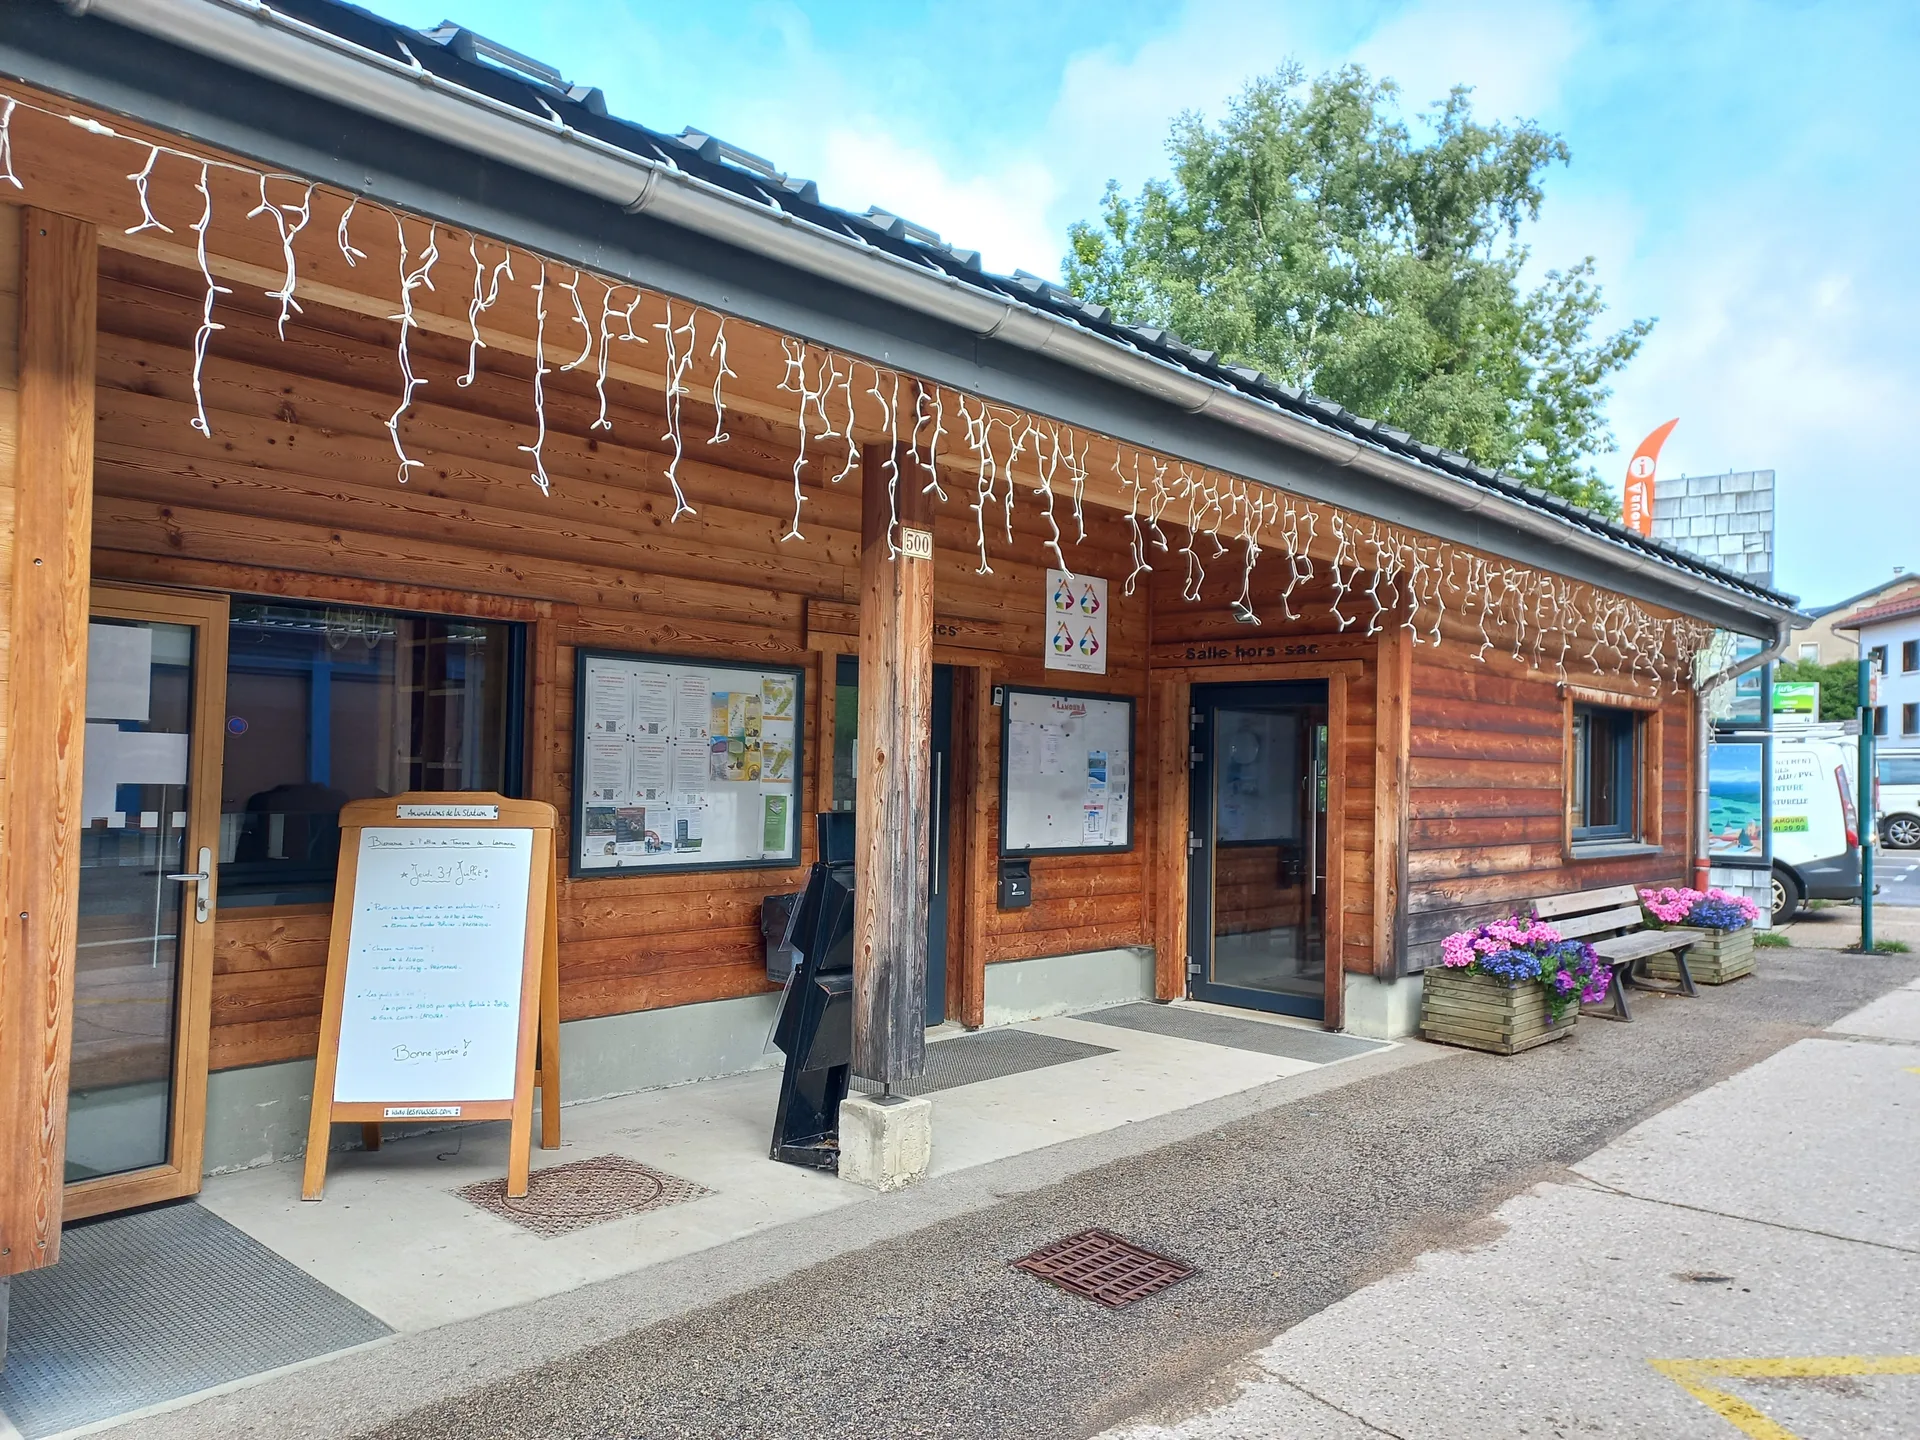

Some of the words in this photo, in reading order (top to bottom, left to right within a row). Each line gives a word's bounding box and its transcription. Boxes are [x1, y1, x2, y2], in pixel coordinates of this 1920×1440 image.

[906, 533, 930, 554] 500
[1185, 646, 1228, 660] Salle
[1235, 644, 1276, 658] hors
[1284, 643, 1319, 656] sac
[1772, 798, 1808, 806] ATURELLE
[407, 808, 445, 817] Animations
[445, 808, 453, 817] de
[453, 807, 461, 817] la
[462, 808, 487, 817] Station
[1773, 817, 1805, 825] AMOURA
[437, 866, 453, 879] 31
[392, 1044, 432, 1062] Bonne
[434, 1045, 459, 1063] journée
